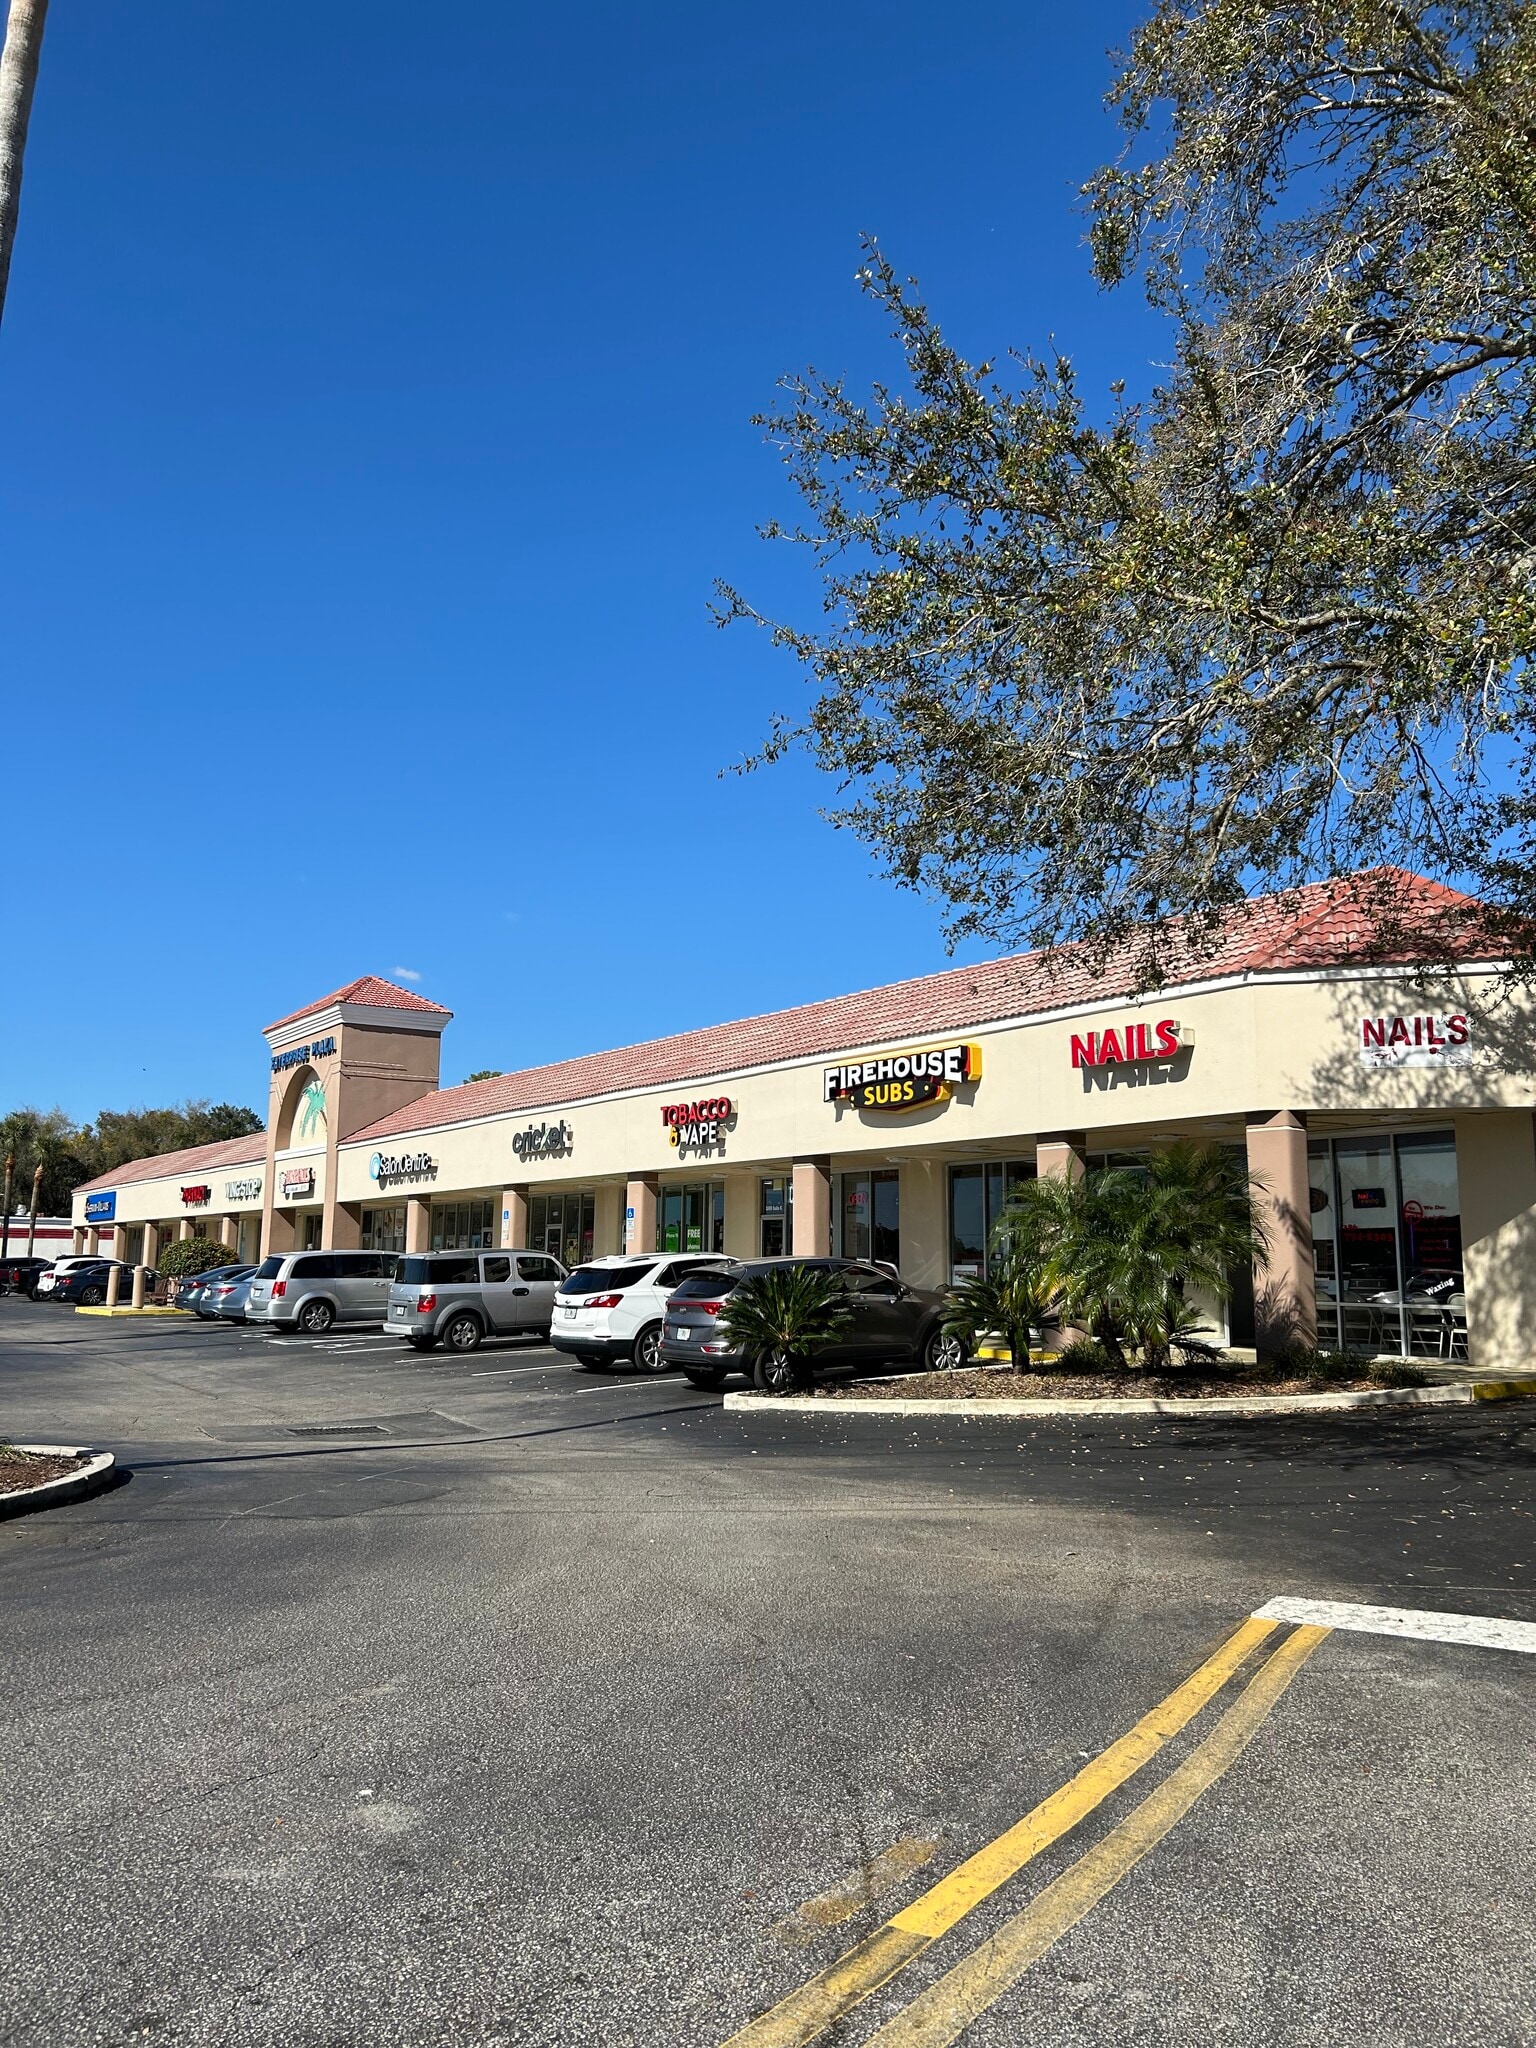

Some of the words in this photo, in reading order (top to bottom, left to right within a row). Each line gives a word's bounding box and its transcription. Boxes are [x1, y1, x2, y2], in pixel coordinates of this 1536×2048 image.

[1070, 1020, 1179, 1068] NAILS
[1362, 1015, 1469, 1047] NAILS
[824, 1046, 963, 1102] FIREHOUSE
[864, 1081, 914, 1105] SUBS
[660, 1097, 729, 1126] TOBACCO
[512, 1120, 567, 1154] cricket
[682, 1121, 717, 1145] VAPE
[380, 1154, 431, 1175] SalonCentric
[687, 1229, 701, 1238] FREE
[1424, 1278, 1454, 1296] Waxing
